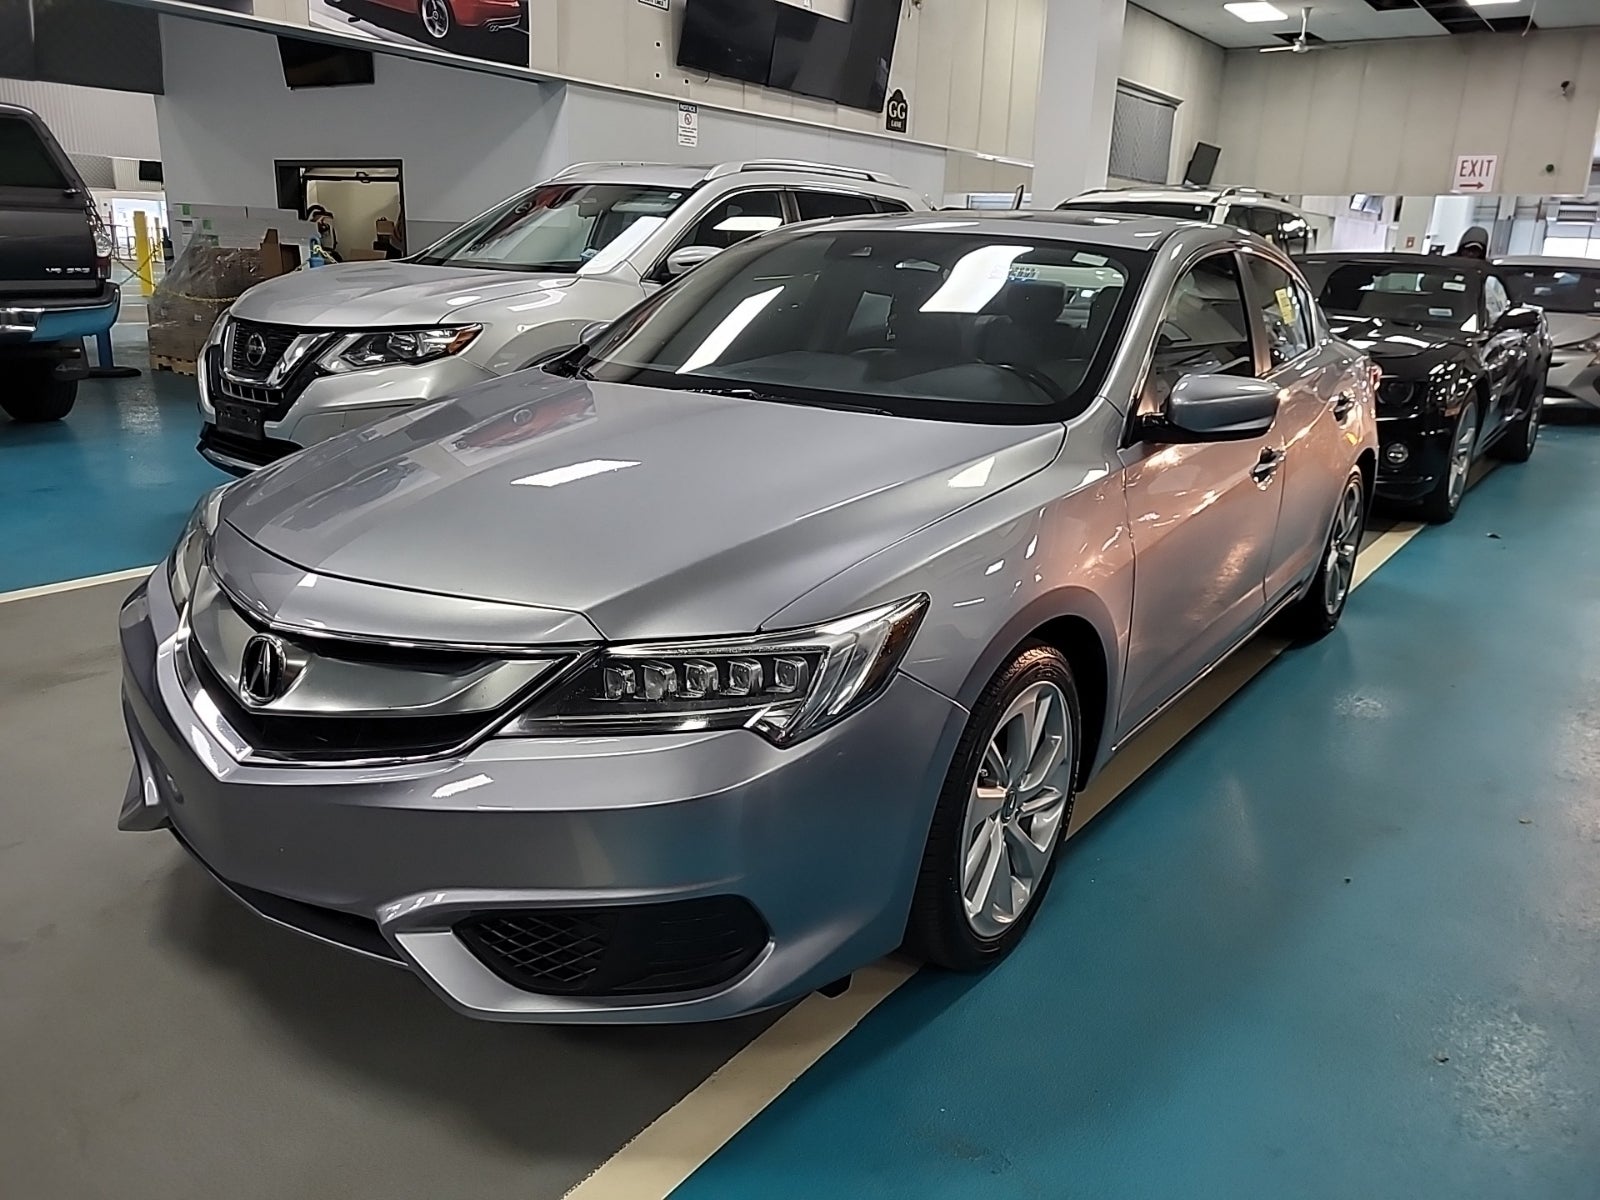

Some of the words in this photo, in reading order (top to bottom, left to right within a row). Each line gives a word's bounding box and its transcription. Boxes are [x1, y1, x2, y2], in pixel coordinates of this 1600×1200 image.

[680, 103, 696, 112] NOTICE
[889, 101, 906, 119] GG
[1459, 160, 1493, 177] EXIT
